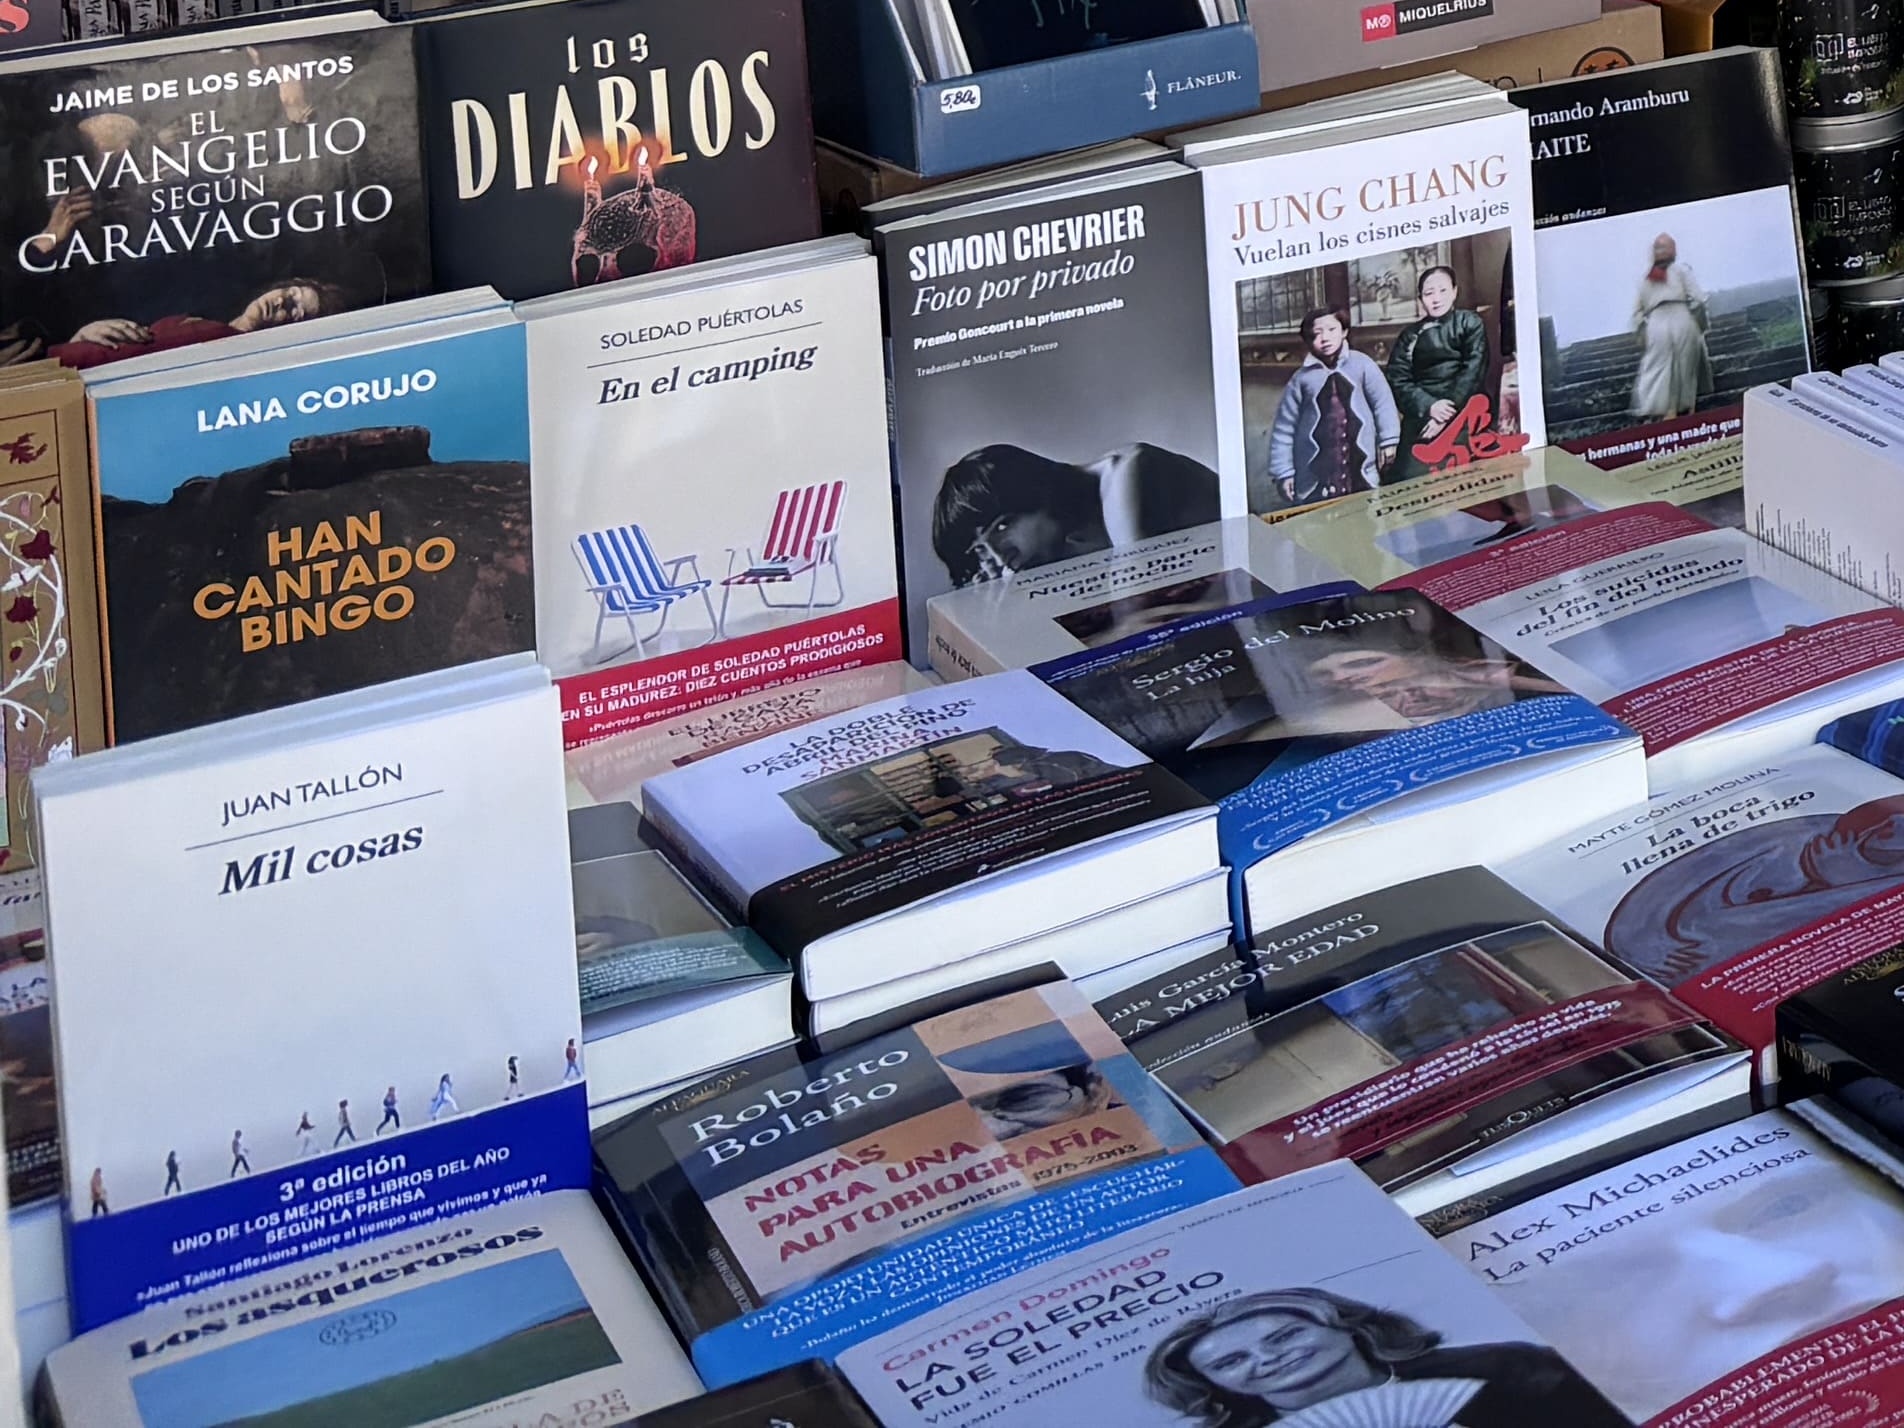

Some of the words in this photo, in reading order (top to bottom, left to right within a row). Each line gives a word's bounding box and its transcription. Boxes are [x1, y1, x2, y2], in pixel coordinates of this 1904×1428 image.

[49, 85, 137, 114] JAIME
[141, 80, 180, 102] DE
[186, 71, 239, 96] LOS
[247, 56, 354, 89] SANTOS
[567, 32, 649, 75] los
[1167, 68, 1242, 94] FLÂNEUR.
[44, 116, 367, 199] EVANGELIO
[189, 111, 226, 137] EL
[451, 51, 777, 201] DIABLOS
[17, 184, 394, 275] CARAVAGGIO
[151, 176, 266, 214] SEGÚN
[1231, 186, 1346, 240] JUNG
[1360, 155, 1509, 217] CHANG
[909, 233, 1009, 282] SIMON
[1012, 203, 1146, 262] CHEVRIER
[1232, 237, 1312, 267] Vuelan
[1316, 228, 1352, 254] los
[1358, 215, 1423, 247] cisnes
[1427, 196, 1512, 239] salvajes
[912, 279, 971, 317] Foto
[977, 274, 1024, 308] por
[1030, 250, 1135, 301] privado
[600, 320, 694, 351] SOLEDAD
[697, 297, 805, 333] PUÉRTOLAS
[196, 392, 288, 434] LANA
[295, 368, 439, 412] CORUJO
[598, 372, 644, 405] En
[650, 365, 682, 395] el
[687, 344, 819, 390] camping
[267, 511, 384, 567] HAN
[192, 536, 457, 622] CANTADO
[240, 586, 416, 654] BINGO
[222, 787, 292, 826] JUAN
[295, 762, 404, 808] TALLÓN
[218, 845, 293, 897] Mil
[307, 823, 424, 878] cosas
[686, 1045, 912, 1144] Roberto
[703, 1077, 900, 1169] Bolaño
[279, 1177, 305, 1203] 3ª
[311, 1151, 407, 1195] edición
[743, 1143, 888, 1213] NOTAS
[758, 1183, 874, 1239] PARA
[884, 1139, 982, 1185] UNA
[778, 1123, 1123, 1264] AUTOBIOGRAFÍA
[1465, 1221, 1554, 1264] Alex
[1561, 1121, 1793, 1223] Michaelides
